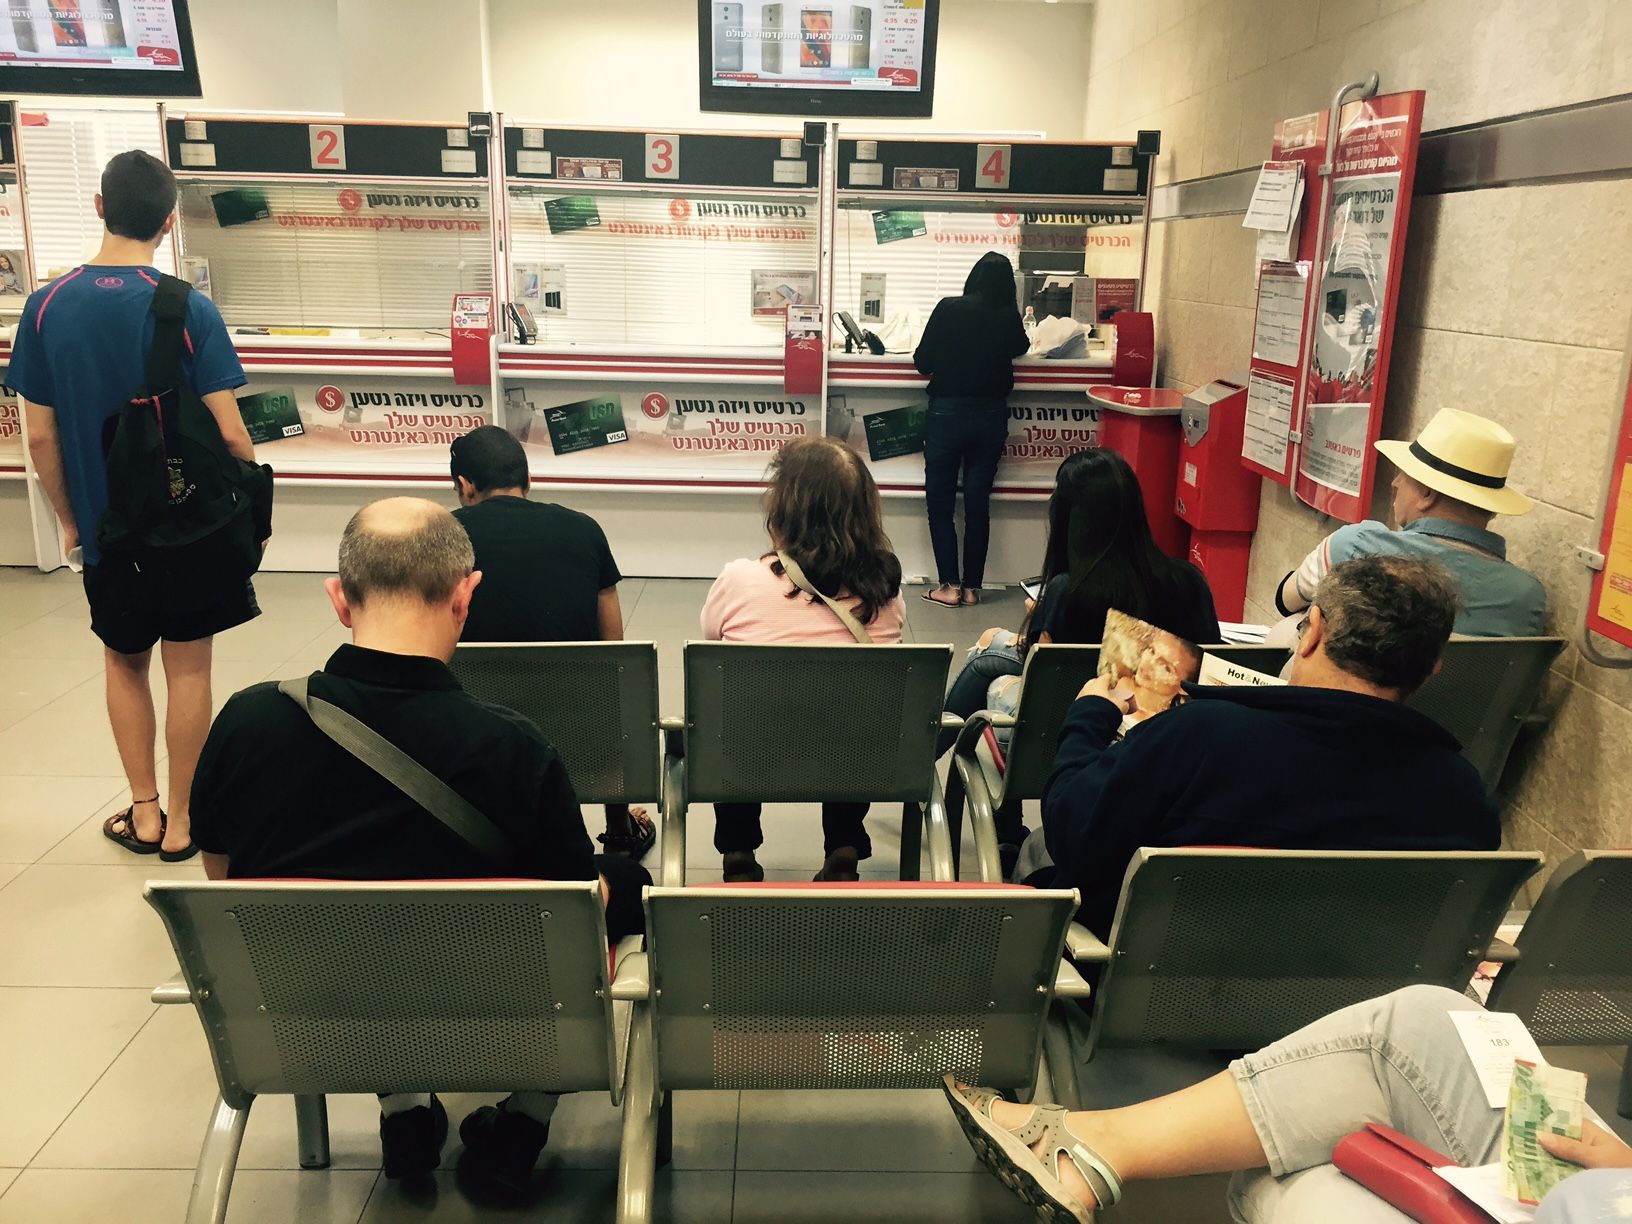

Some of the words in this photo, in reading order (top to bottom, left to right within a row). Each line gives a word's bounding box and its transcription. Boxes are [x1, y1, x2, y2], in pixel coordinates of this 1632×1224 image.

[316, 130, 340, 165] 2
[651, 139, 673, 174] 3
[982, 149, 1005, 184] 4
[402, 194, 430, 207] ויזה
[433, 195, 479, 208] כרטיס
[697, 203, 730, 216] נטען
[732, 204, 761, 217] ויזה
[763, 205, 806, 218] כרטיס
[427, 219, 480, 231] הכרטיס
[1080, 235, 1131, 248] הכרטיס
[350, 391, 390, 409] נטען
[394, 393, 427, 407] ויזה
[430, 394, 484, 408] כרטיס
[719, 400, 750, 414] ויזה
[675, 398, 715, 417] נטען
[753, 401, 805, 415] כרטיס
[1036, 407, 1068, 421] ויזה
[384, 411, 418, 429] שלך
[422, 414, 484, 429] הכרטיס
[284, 426, 302, 435] VISA
[707, 418, 738, 437] שלך
[743, 421, 806, 435] הכרטיס
[1023, 425, 1057, 443] שלך
[350, 430, 429, 445] באינטרנט
[608, 433, 625, 441] VISA
[672, 437, 750, 451] באינטרנט
[1228, 668, 1245, 681] Hot
[1490, 1038, 1510, 1047] 183
